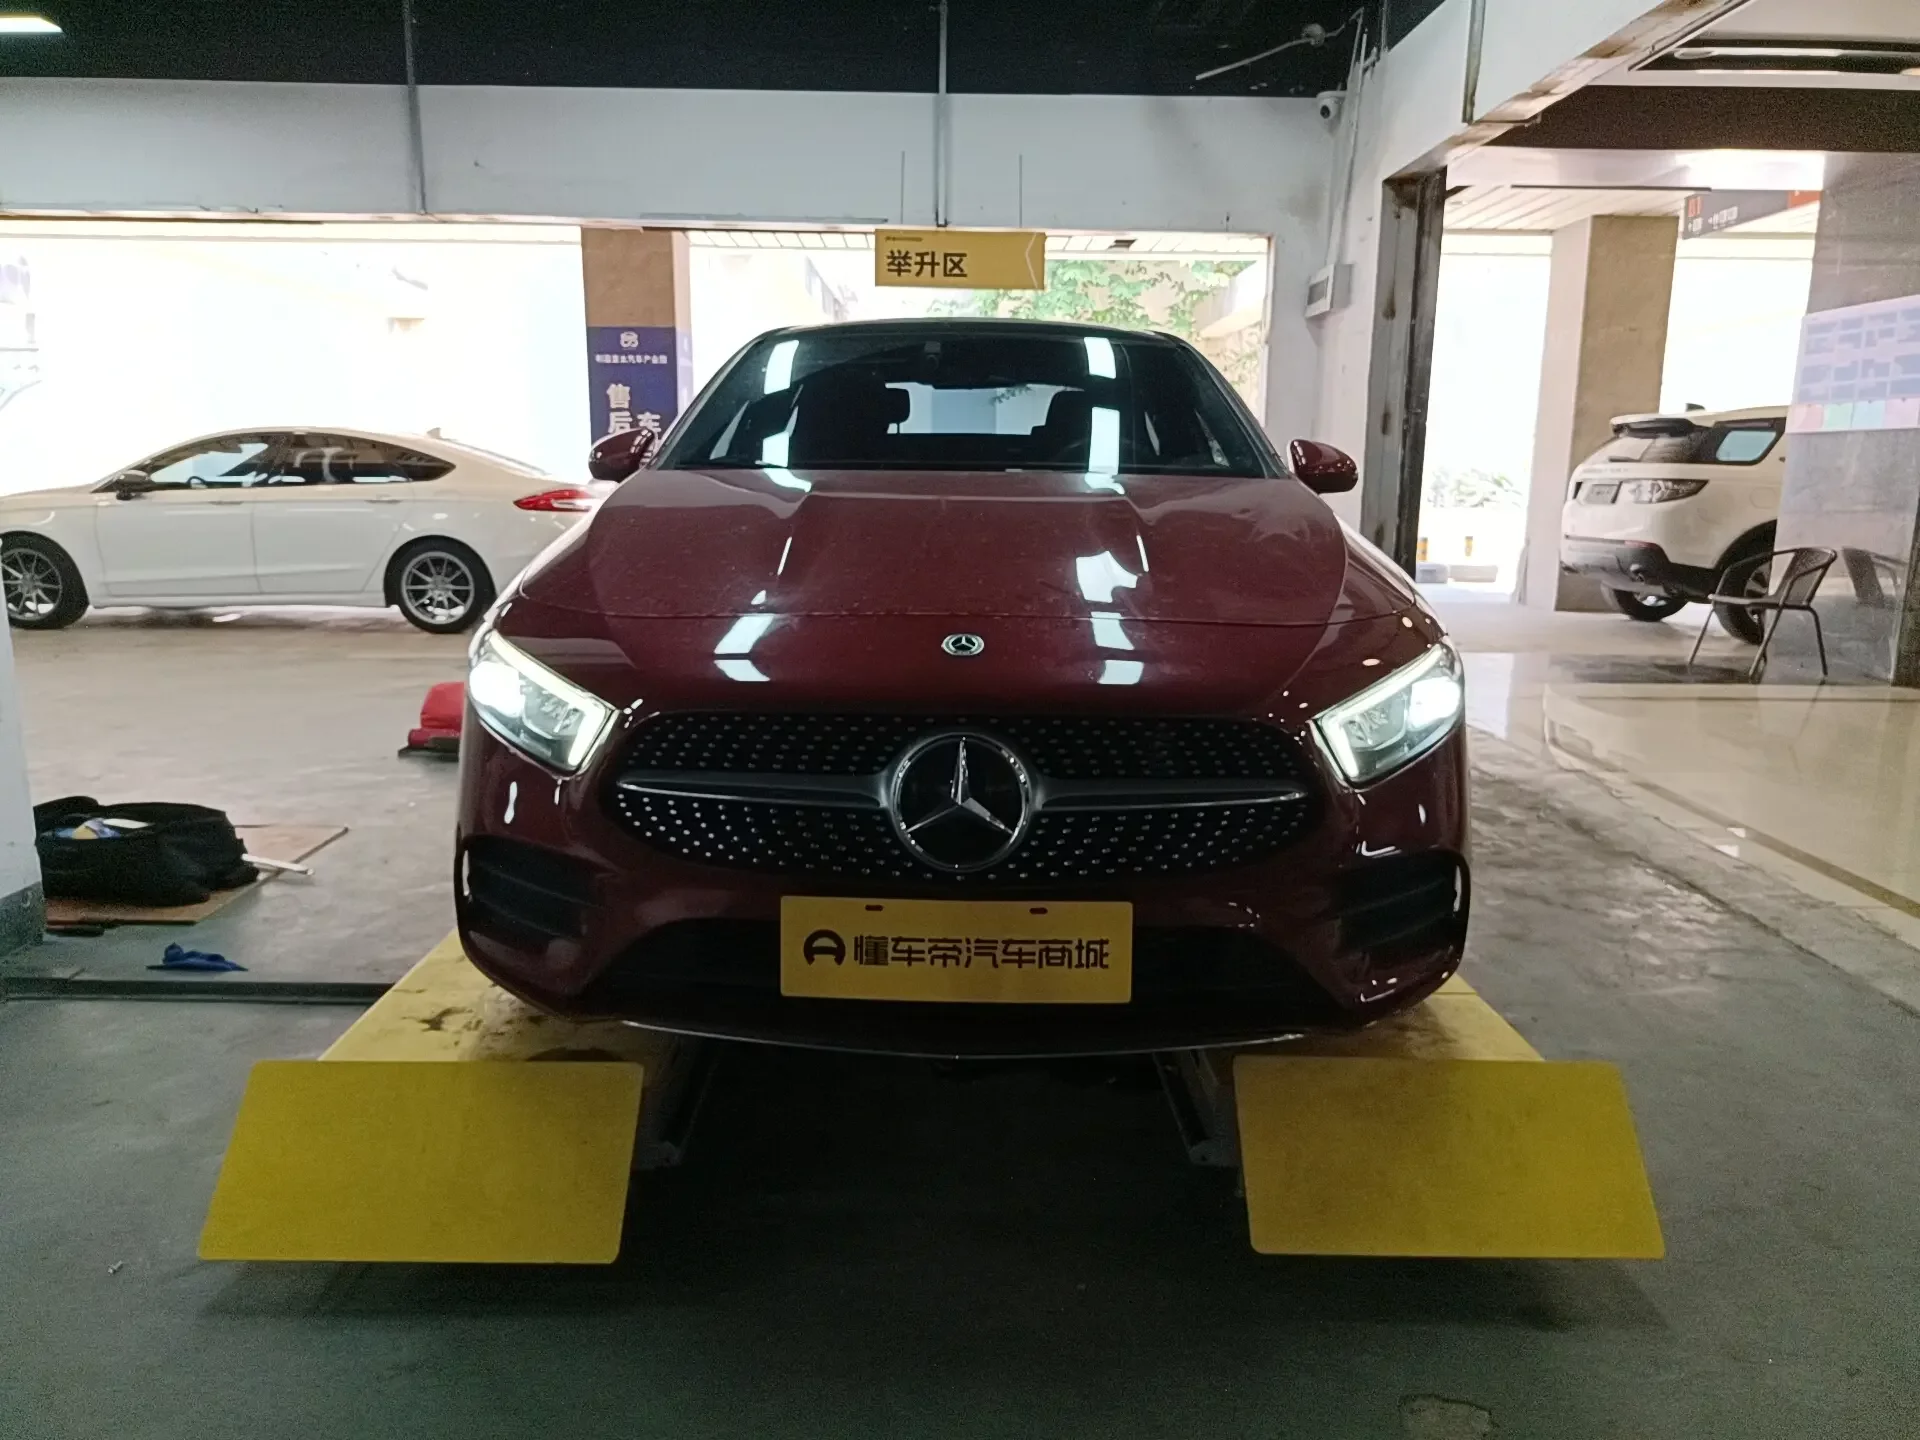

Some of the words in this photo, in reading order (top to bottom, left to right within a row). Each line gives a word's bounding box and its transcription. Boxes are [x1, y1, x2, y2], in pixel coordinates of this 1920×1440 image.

[886, 250, 967, 277] 举升区
[853, 935, 1110, 969] 懂车帝汽车商城
